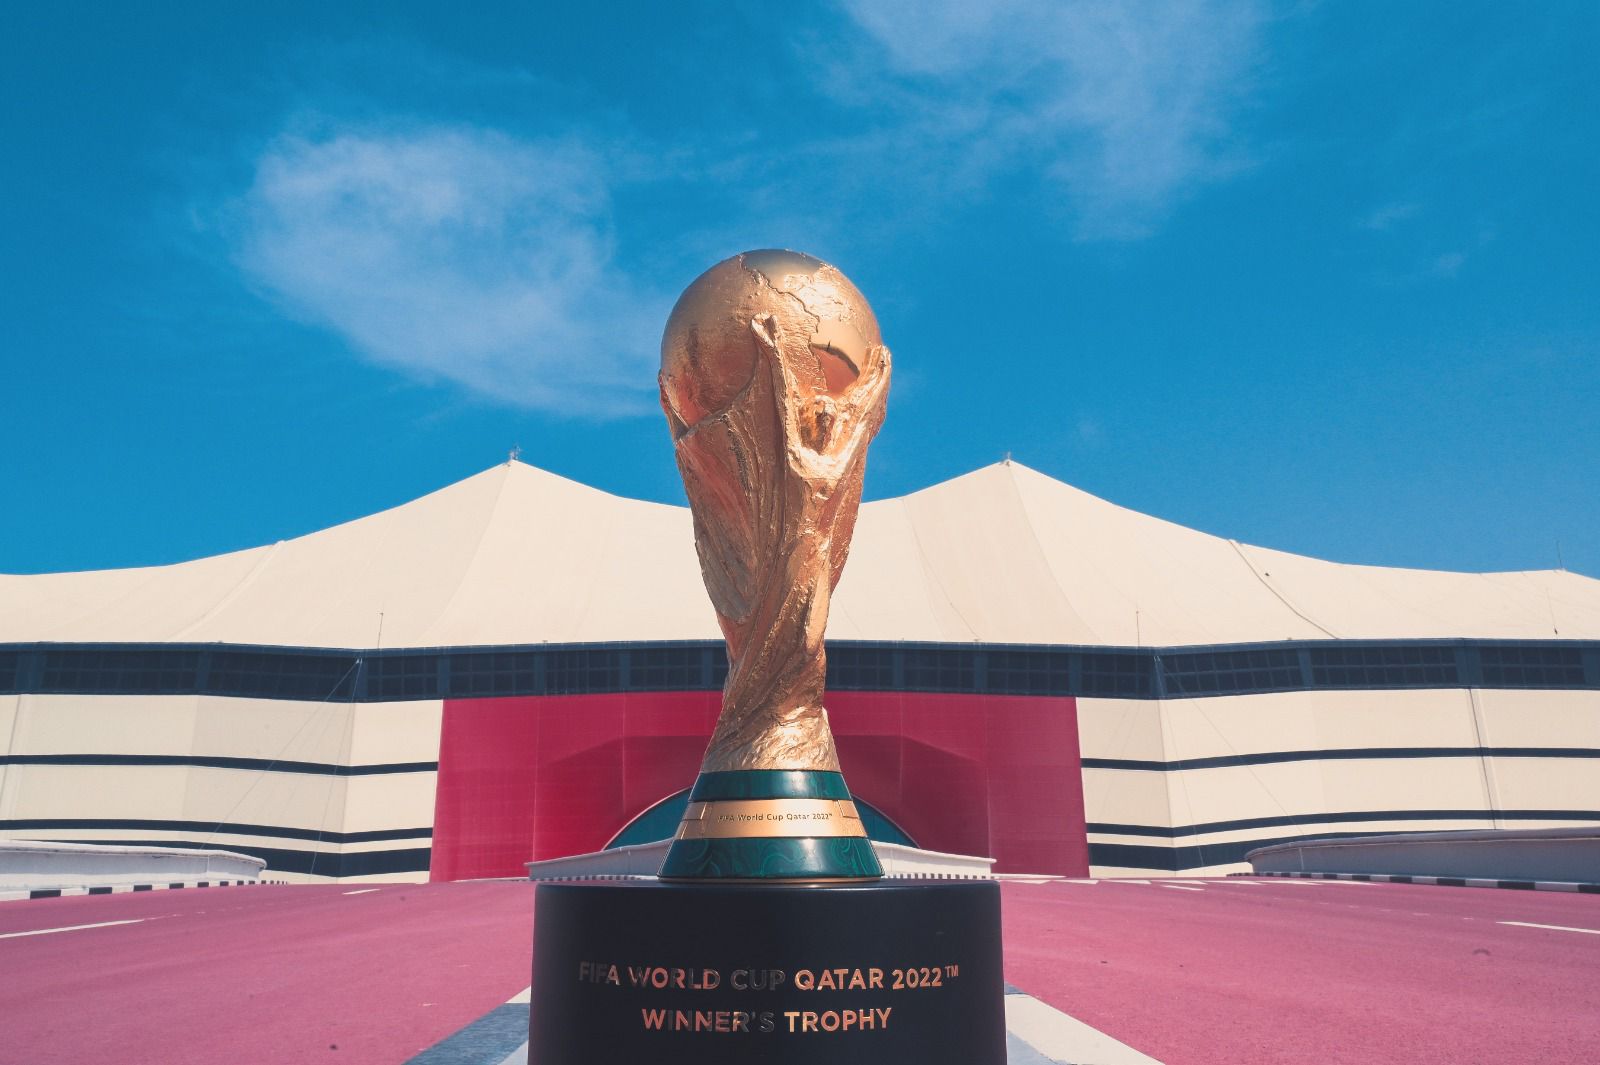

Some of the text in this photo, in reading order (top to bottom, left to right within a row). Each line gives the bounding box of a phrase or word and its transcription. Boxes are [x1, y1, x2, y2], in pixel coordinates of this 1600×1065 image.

[738, 813, 764, 821] World
[767, 813, 784, 823] Cup
[786, 813, 810, 821] Qatar
[578, 961, 621, 986] FIFA
[627, 966, 721, 990] WORLD
[730, 969, 786, 991] CUP
[794, 967, 884, 991] QATAR
[641, 1007, 892, 1033] WINNER'S TROPHY
